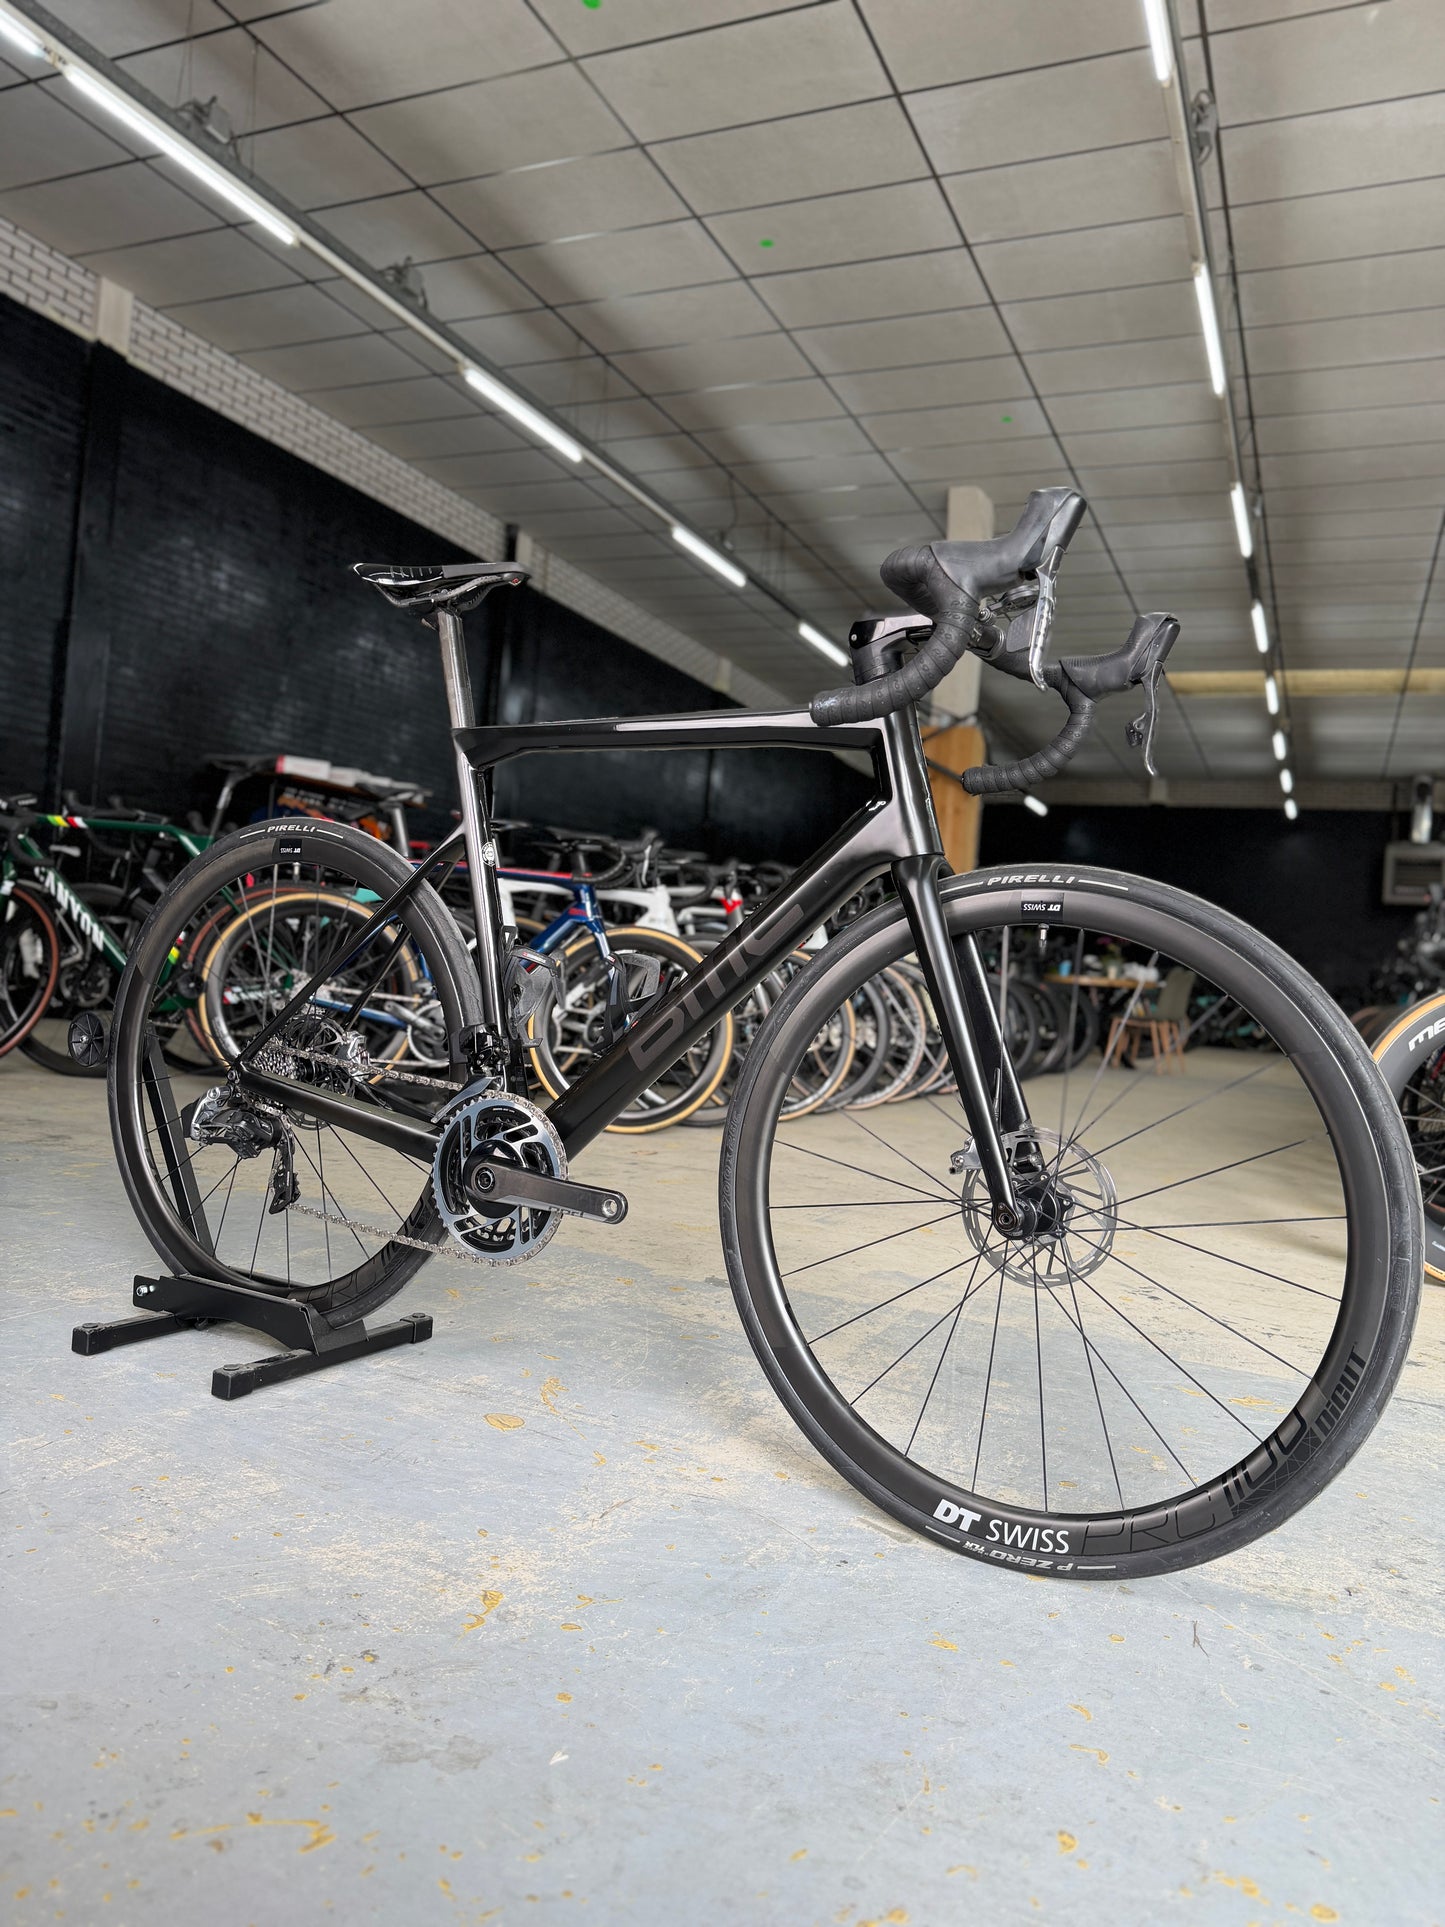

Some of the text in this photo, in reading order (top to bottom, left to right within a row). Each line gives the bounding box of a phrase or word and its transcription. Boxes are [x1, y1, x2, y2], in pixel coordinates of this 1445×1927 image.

[267, 824, 316, 833] PIRELLI
[987, 874, 1075, 885] PIRELLI
[34, 866, 104, 951] CANYON
[1023, 903, 1061, 912] DT SWISS
[932, 1498, 982, 1532] DT
[985, 1519, 1070, 1554] SWISS
[1081, 1490, 1216, 1555] PRC
[989, 1549, 1054, 1569] ZERO
